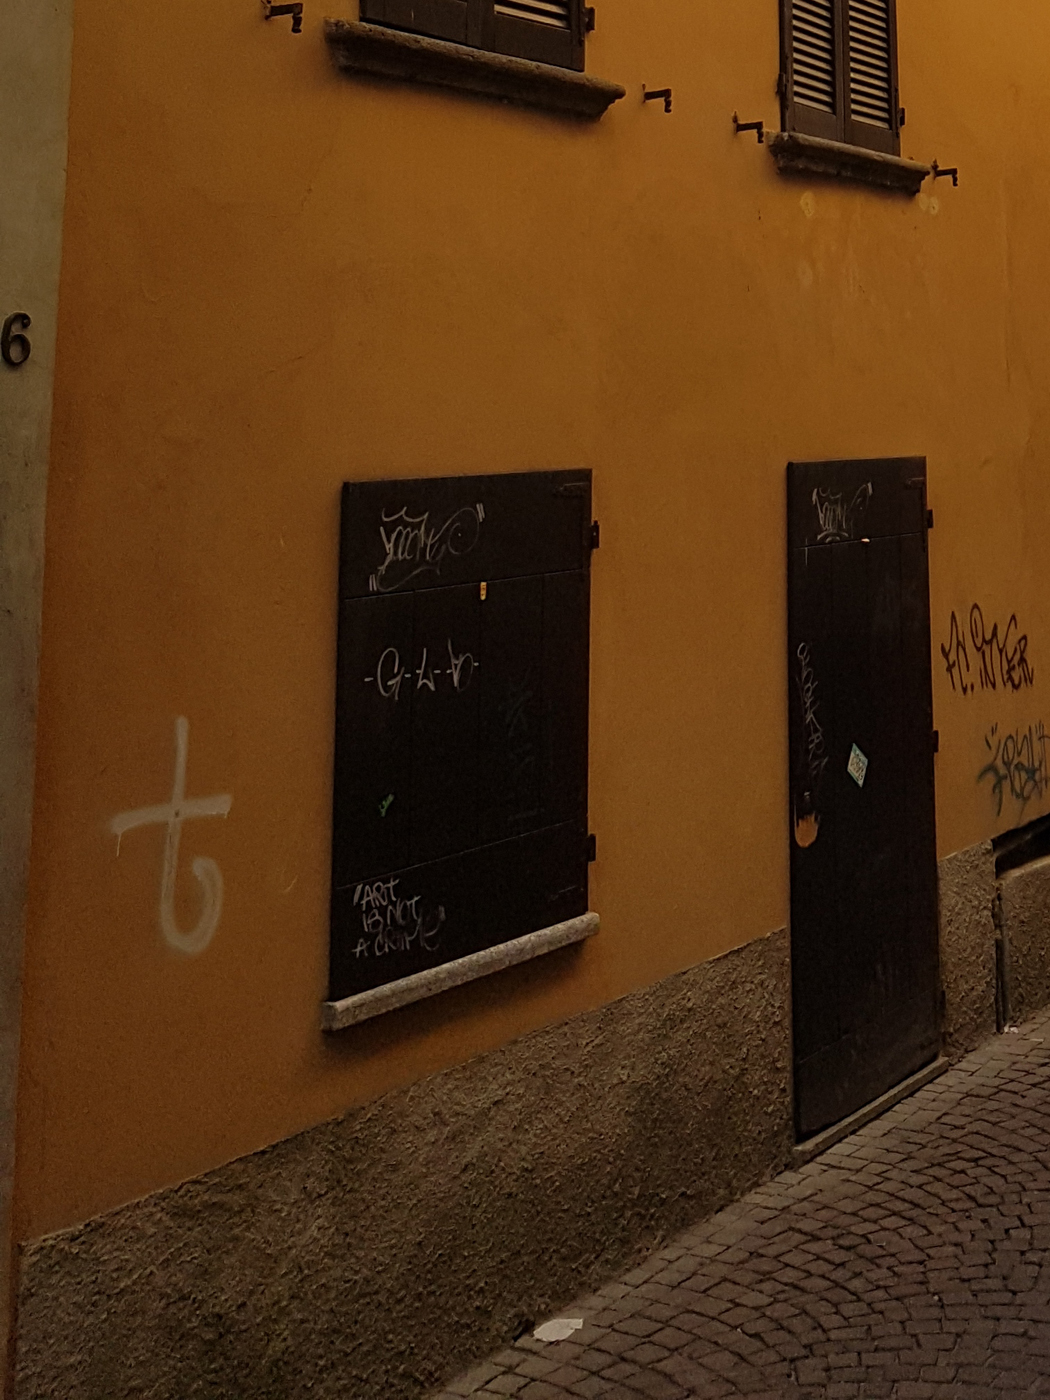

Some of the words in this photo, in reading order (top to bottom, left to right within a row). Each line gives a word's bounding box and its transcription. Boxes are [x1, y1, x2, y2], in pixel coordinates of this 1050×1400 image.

[1, 311, 32, 369] 6
[387, 895, 421, 926] NOT
[352, 937, 371, 958] A
